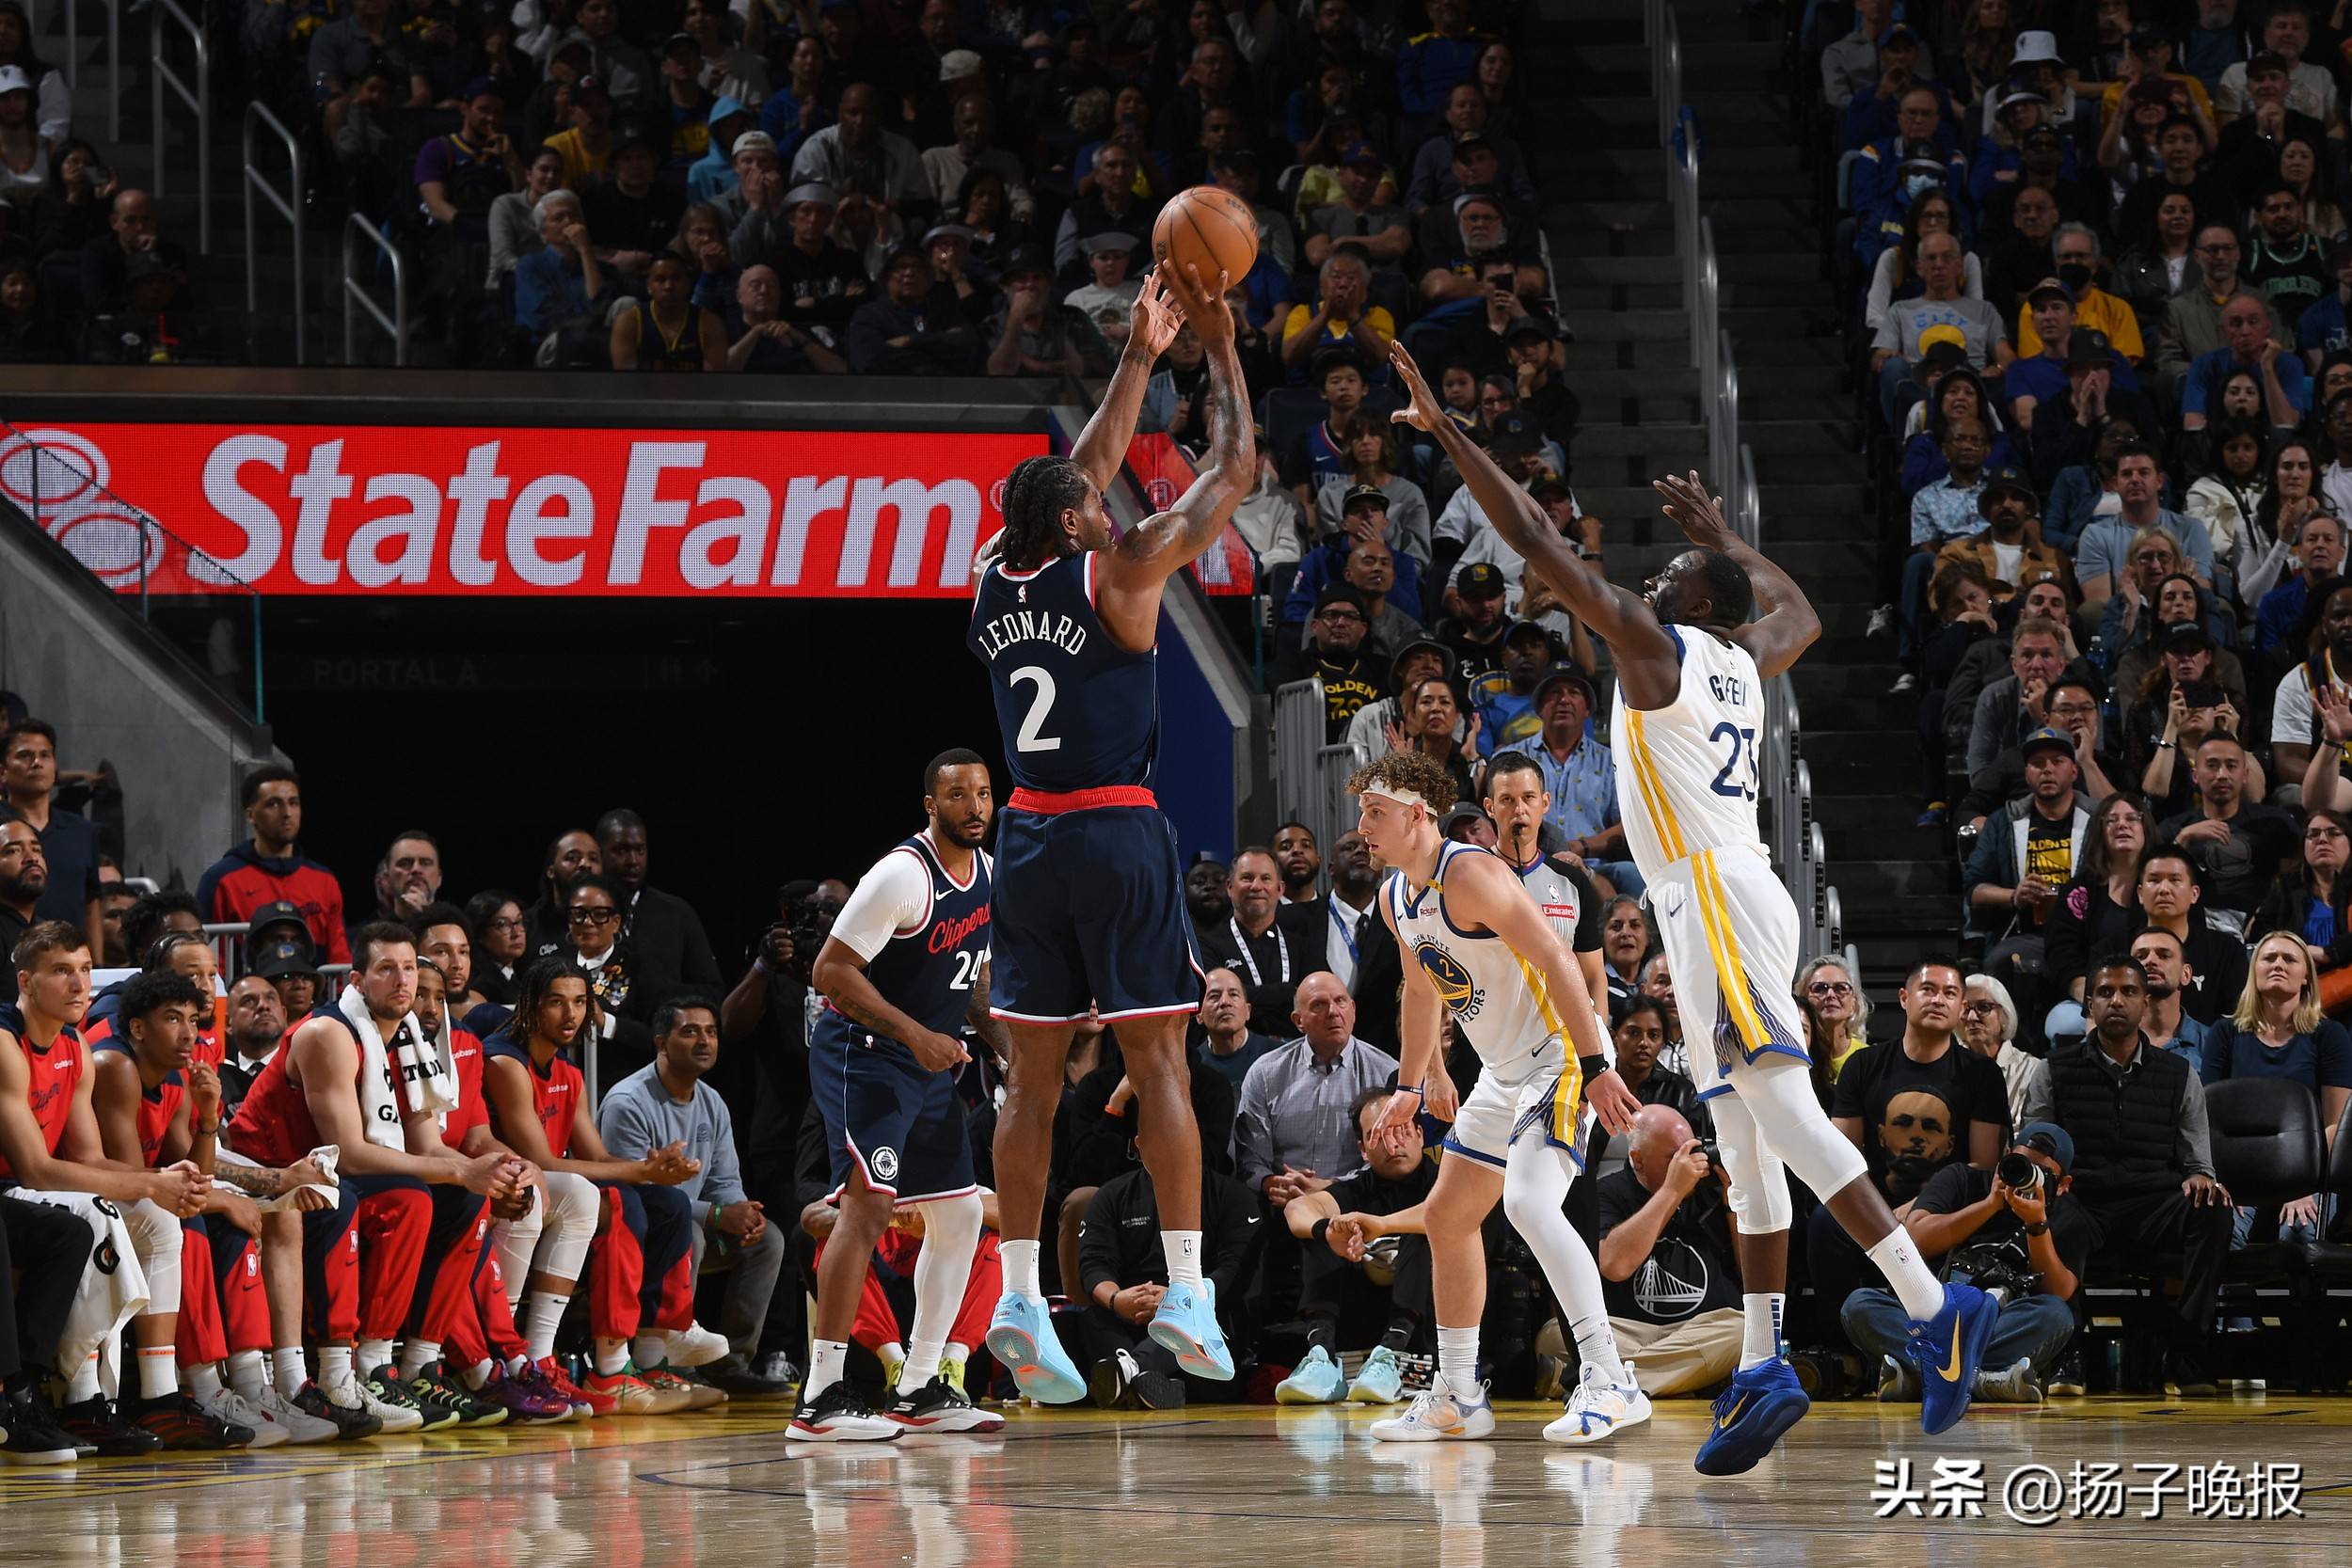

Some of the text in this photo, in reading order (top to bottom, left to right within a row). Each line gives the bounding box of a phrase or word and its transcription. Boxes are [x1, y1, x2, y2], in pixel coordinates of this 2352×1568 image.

[977, 610, 1088, 660] LEONARD
[312, 659, 481, 686] PORTAL A
[1324, 679, 1378, 701] OLDEN
[1009, 665, 1061, 752] 2
[1708, 721, 1757, 802] 23
[927, 902, 991, 953] Clippers
[1426, 934, 1451, 954] STATE
[949, 950, 985, 990] 24
[1439, 958, 1455, 977] 2
